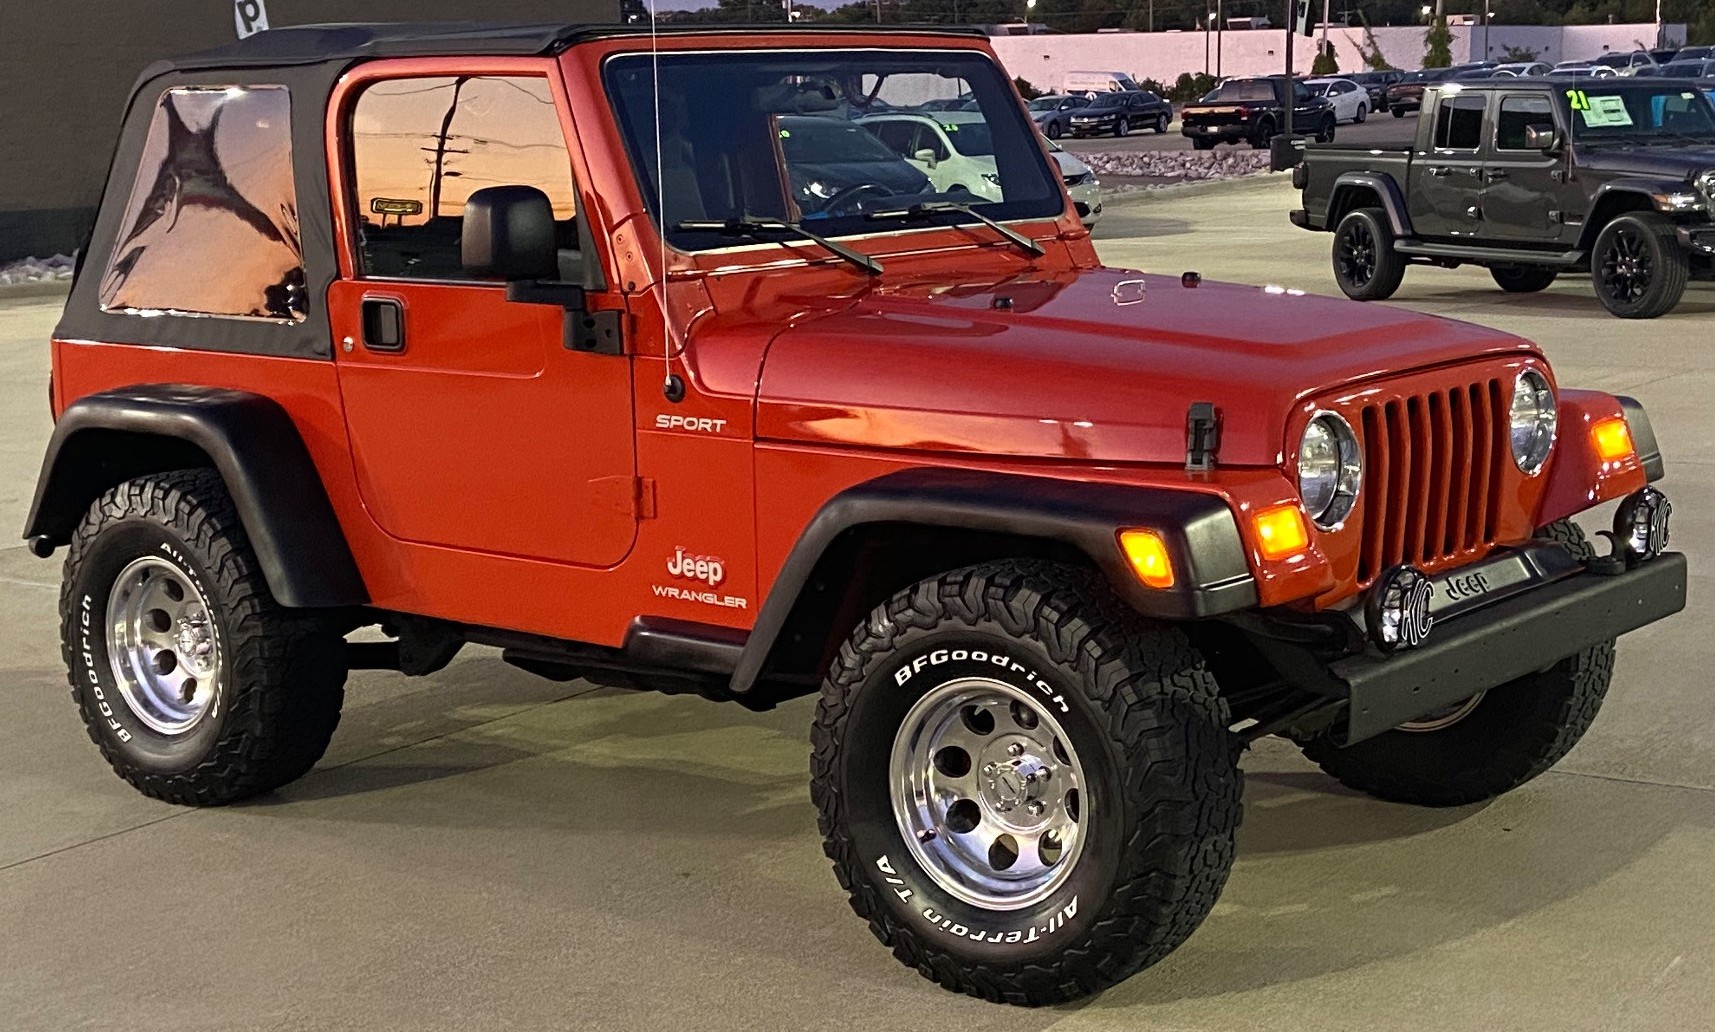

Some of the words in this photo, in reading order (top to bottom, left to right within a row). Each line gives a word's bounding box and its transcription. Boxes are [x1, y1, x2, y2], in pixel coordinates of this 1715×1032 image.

[1566, 90, 1590, 110] 21
[655, 414, 727, 432] SPORT
[1650, 497, 1673, 556] KC
[667, 548, 724, 586] Jeep
[1445, 571, 1489, 601] Jeep
[652, 584, 748, 609] WRANGLER
[1402, 578, 1435, 646] KC
[82, 594, 132, 743] BFGoodrich
[894, 649, 1069, 713] BFGoodrich
[875, 854, 916, 904] T/A
[922, 895, 1079, 944] All-Terrain
